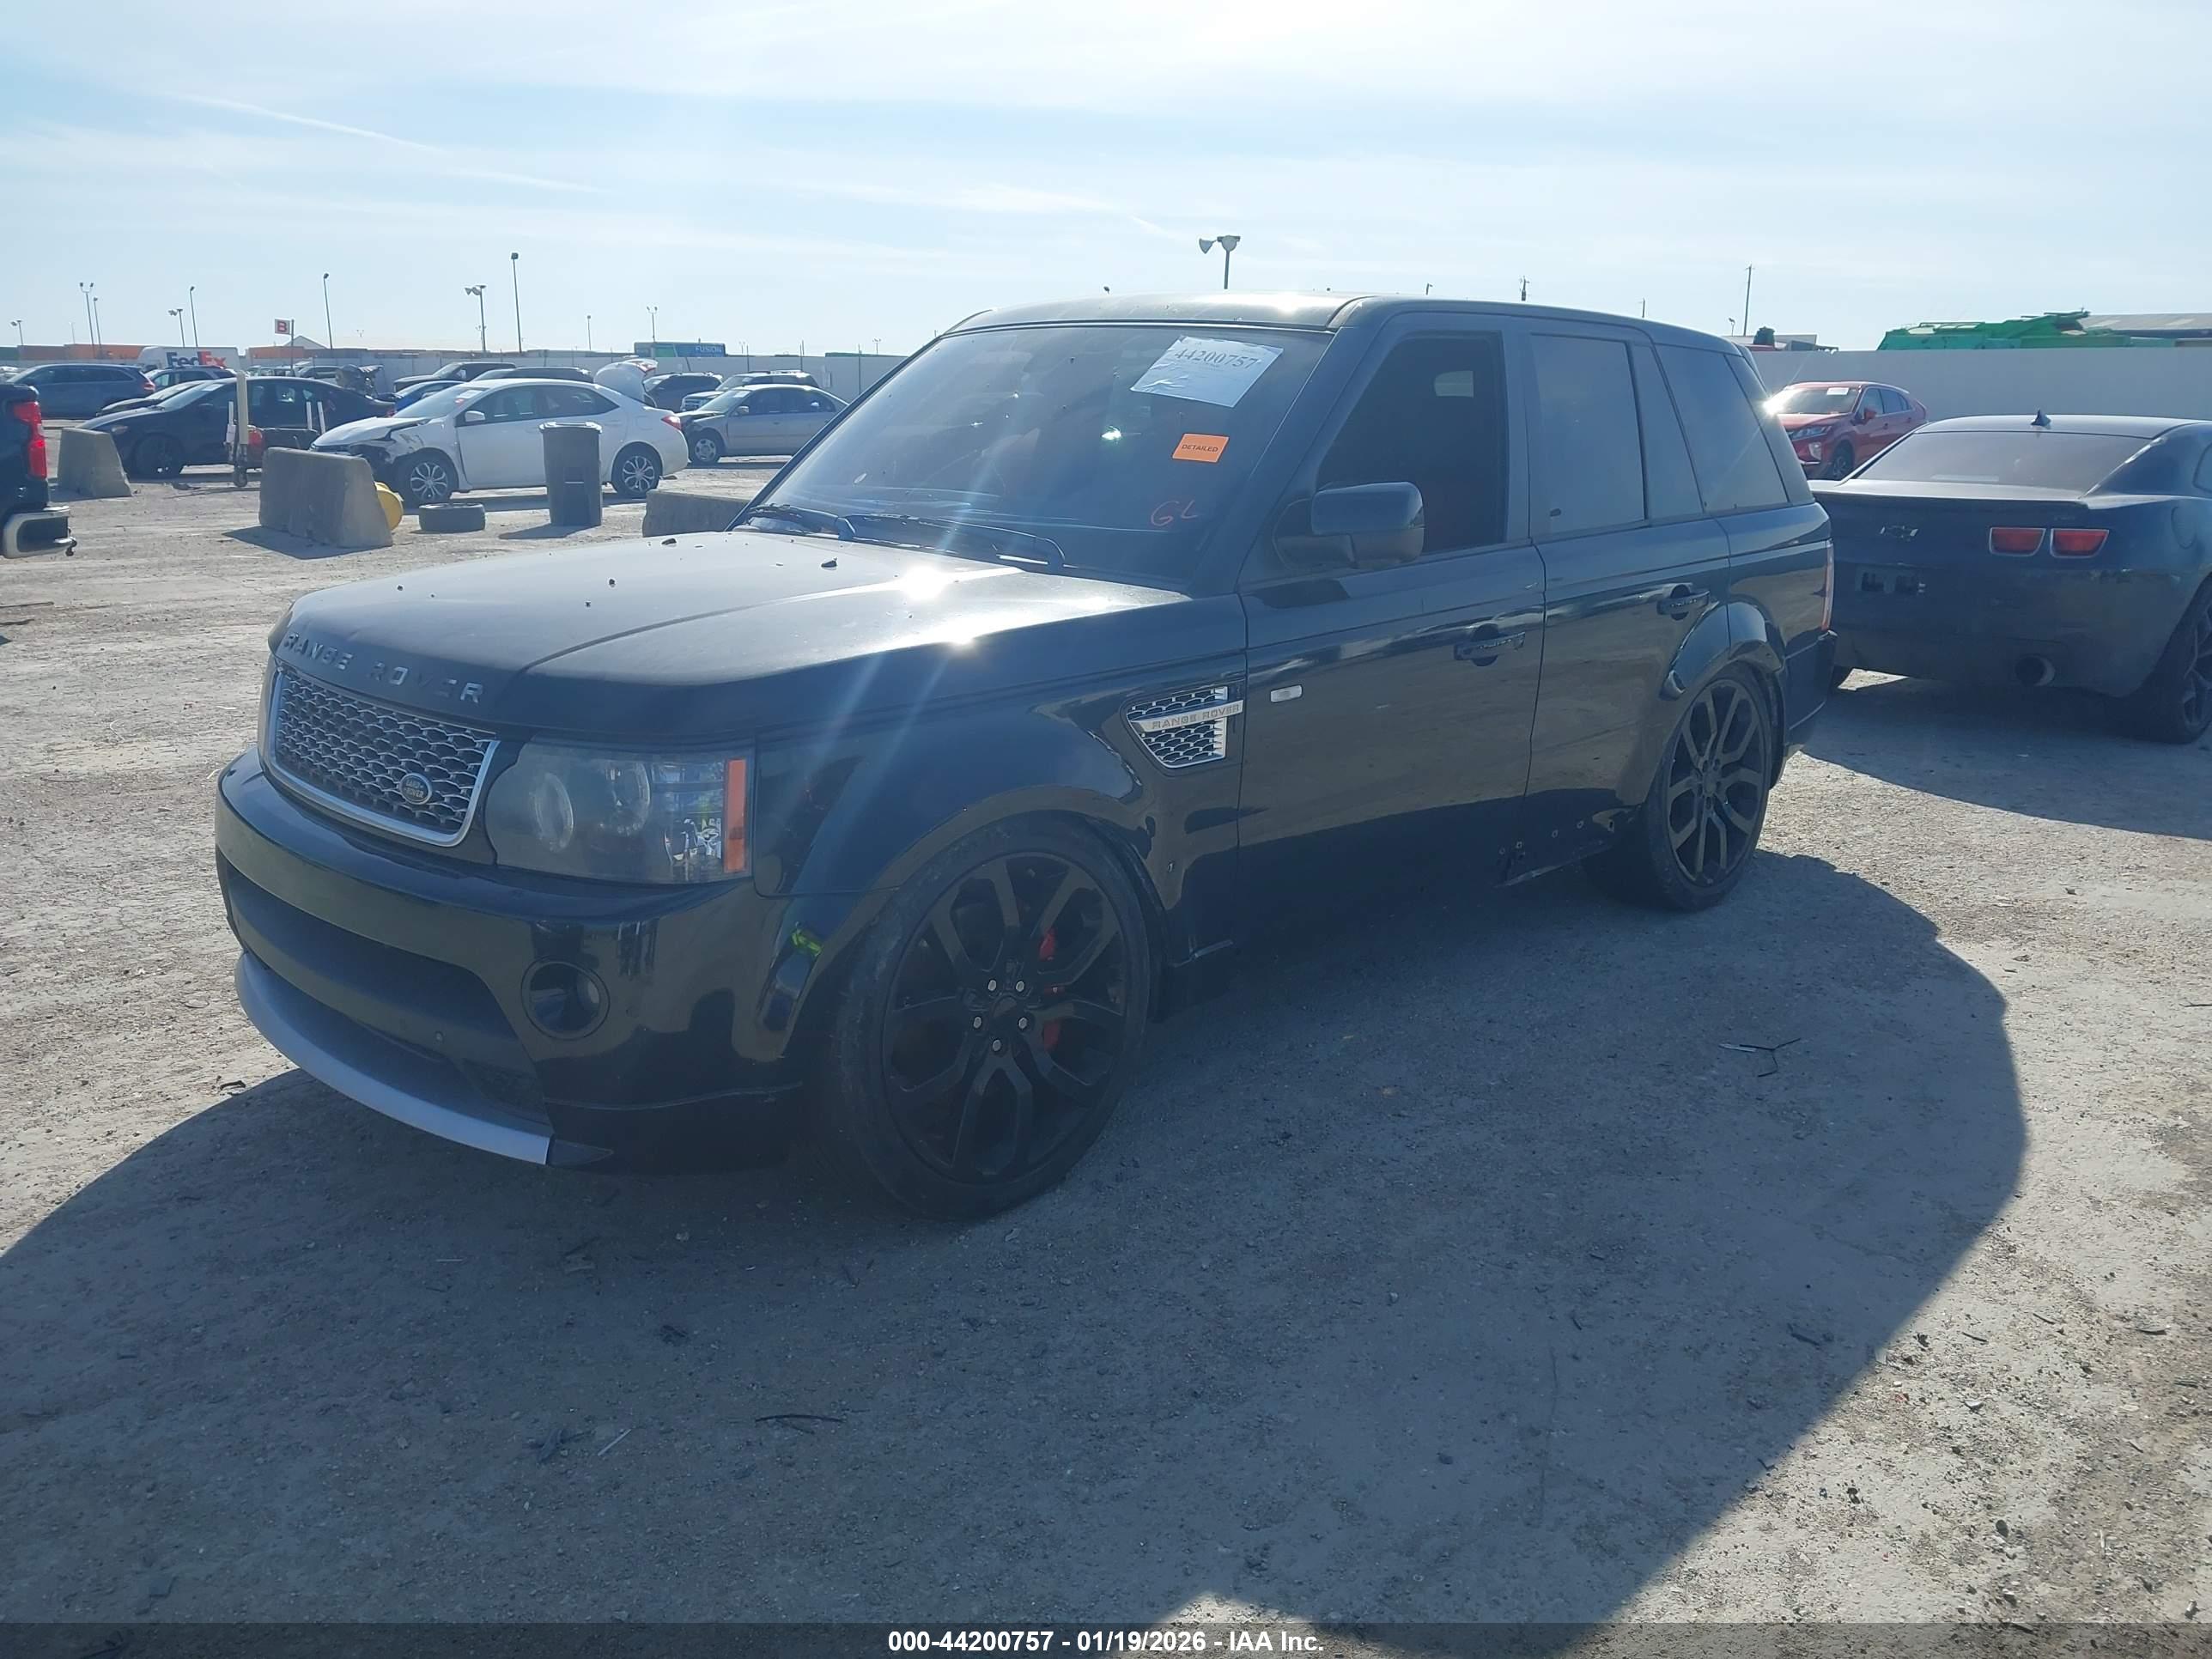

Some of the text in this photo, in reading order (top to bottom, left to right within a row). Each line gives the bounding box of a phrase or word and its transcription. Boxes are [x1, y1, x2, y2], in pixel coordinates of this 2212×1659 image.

[167, 351, 226, 367] FedEx
[1174, 349, 1259, 369] 44200757
[1182, 444, 1218, 453] DETAILED
[284, 633, 483, 704] RANGE ROVER
[1152, 704, 1239, 730] RANGE ROVER
